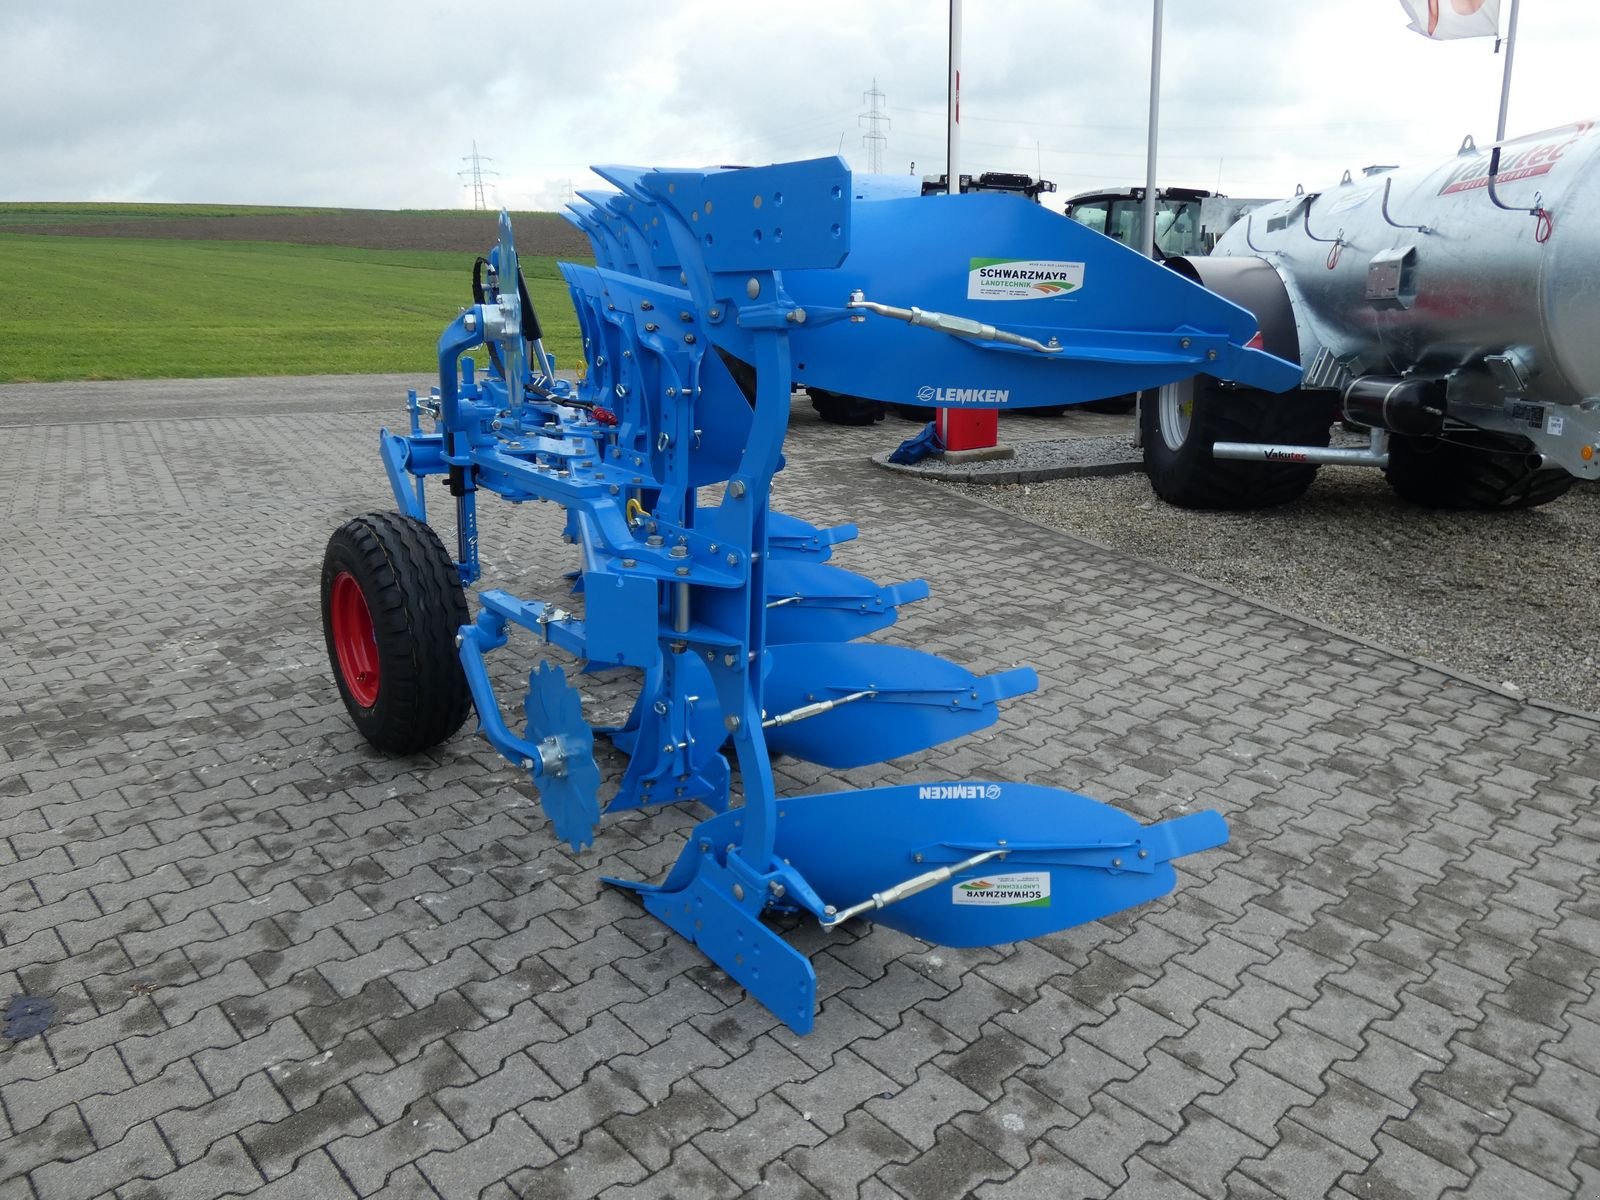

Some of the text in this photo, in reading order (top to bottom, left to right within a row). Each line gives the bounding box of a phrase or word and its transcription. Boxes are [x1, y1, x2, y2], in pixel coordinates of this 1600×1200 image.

[979, 268, 1068, 281] SCHWARZMAYR
[980, 279, 1032, 289] LANDTECHNIK
[936, 388, 1010, 404] LEMKEN
[1264, 448, 1307, 462] Vakutec
[919, 784, 985, 800] LEMKEN
[966, 890, 1042, 899] SCHWARZMAYR
